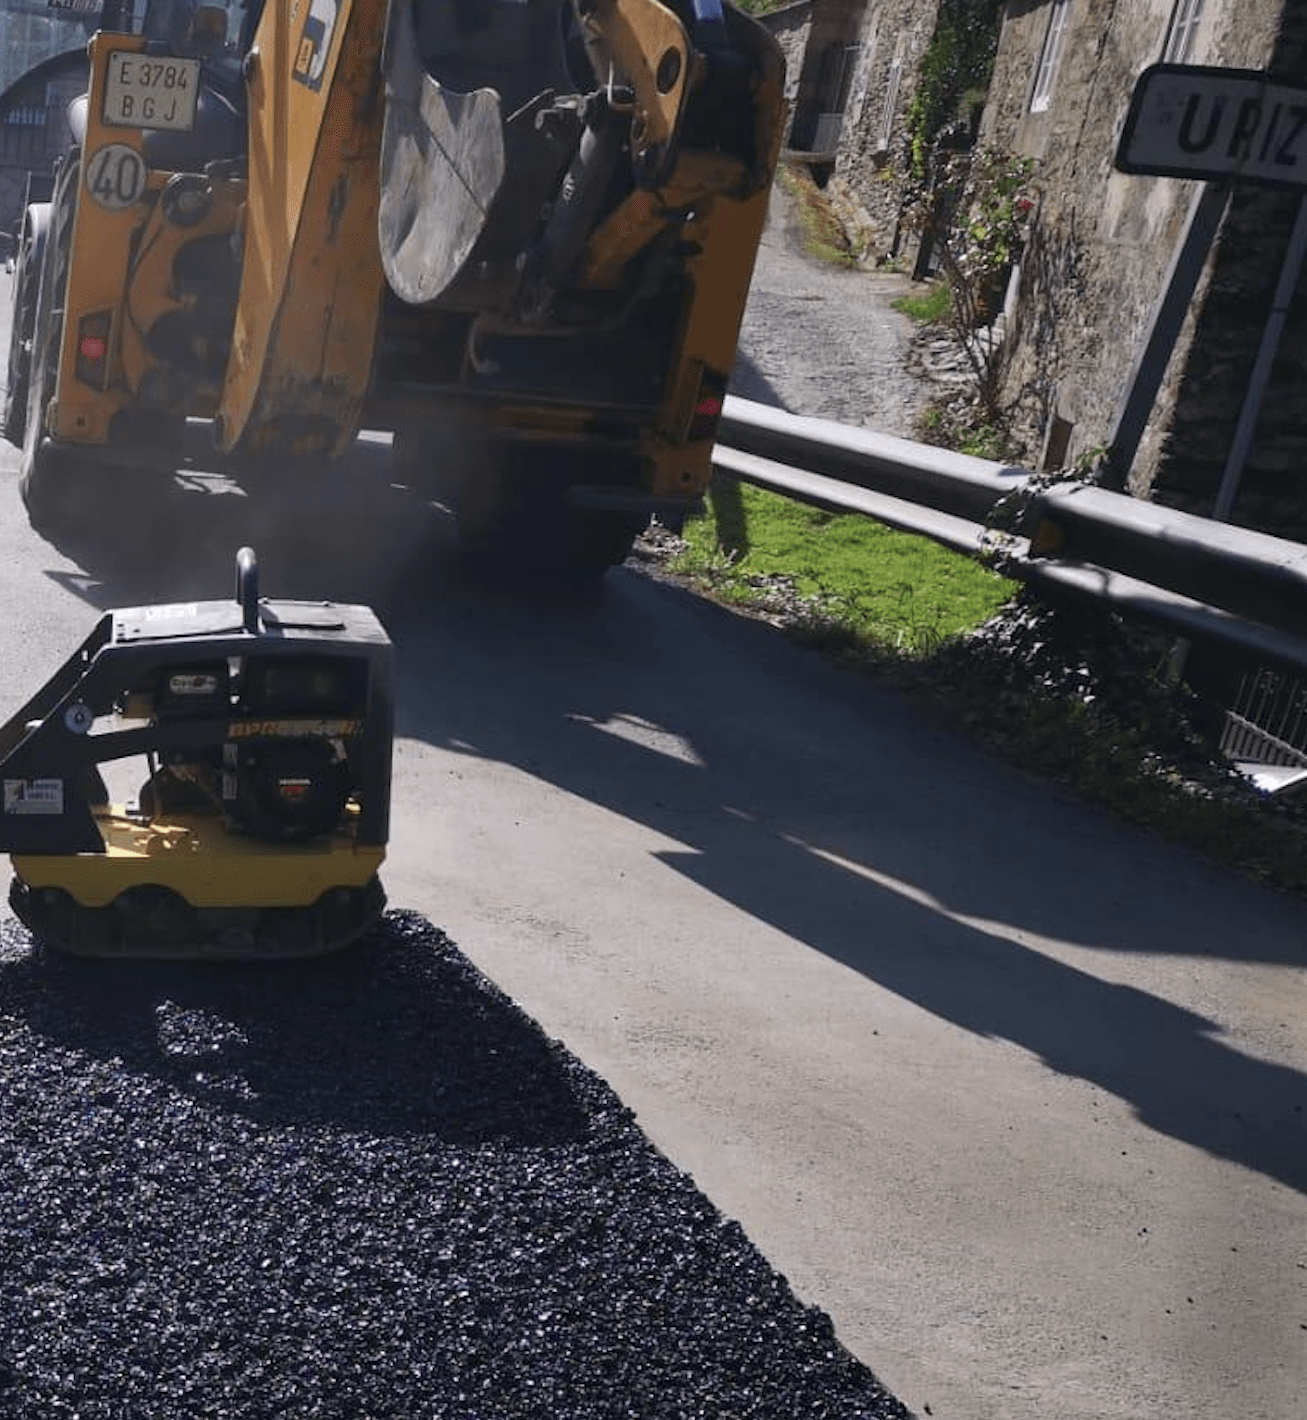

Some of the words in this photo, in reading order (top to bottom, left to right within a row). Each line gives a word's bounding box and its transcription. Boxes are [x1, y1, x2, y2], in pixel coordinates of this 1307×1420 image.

[120, 61, 132, 84] E
[139, 63, 187, 89] 3784
[92, 150, 140, 201] 40
